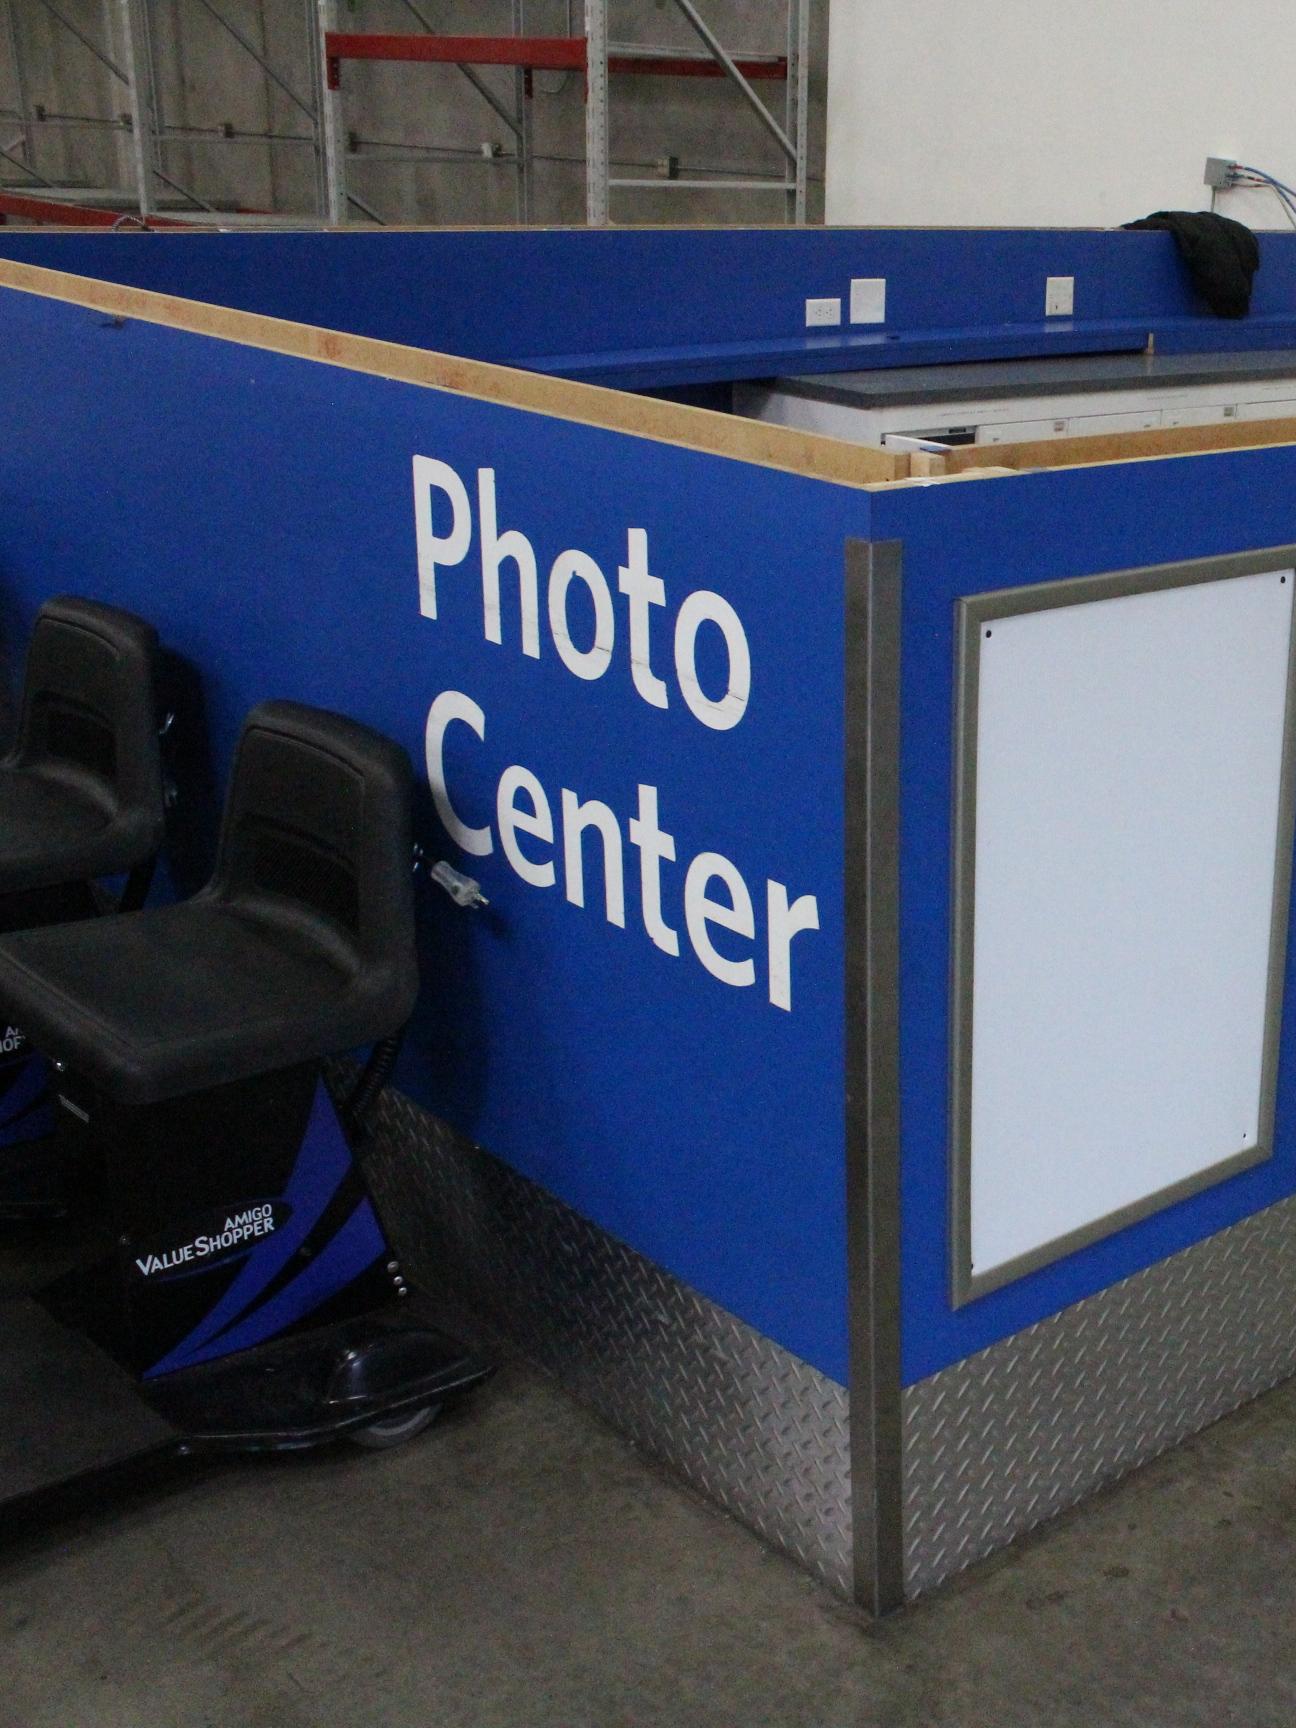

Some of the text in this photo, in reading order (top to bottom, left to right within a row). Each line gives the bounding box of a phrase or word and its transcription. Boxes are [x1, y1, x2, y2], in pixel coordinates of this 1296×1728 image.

[412, 454, 751, 730] Photo
[425, 690, 820, 1012] Center
[224, 1203, 272, 1232] AMIGO
